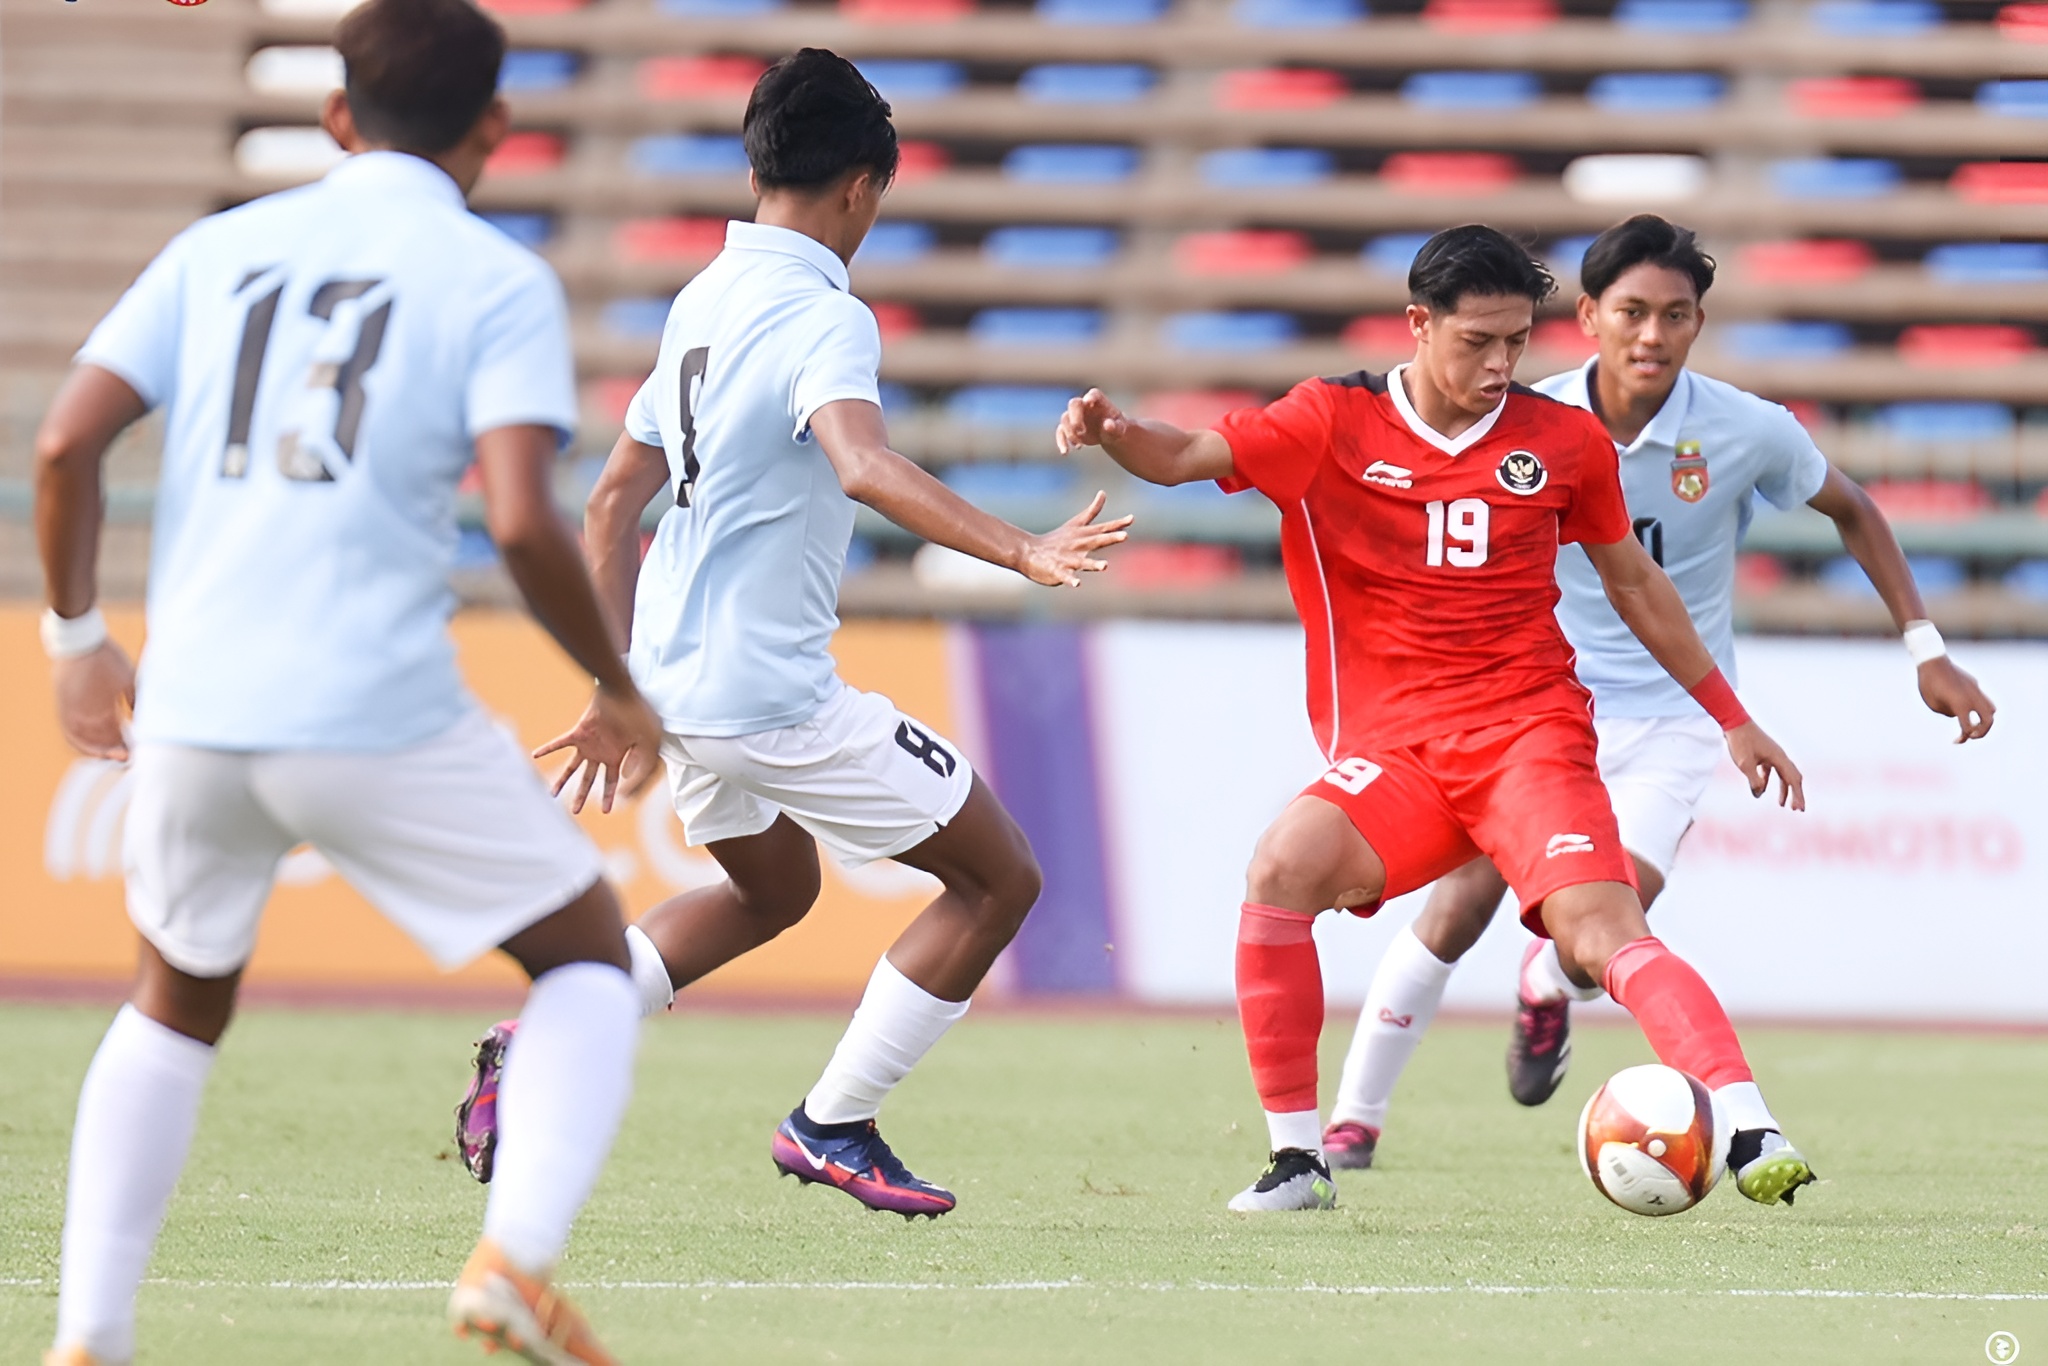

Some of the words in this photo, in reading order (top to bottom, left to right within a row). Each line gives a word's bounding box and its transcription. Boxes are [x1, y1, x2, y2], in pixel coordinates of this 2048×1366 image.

[220, 264, 395, 482] 13
[1425, 498, 1490, 568] 19
[894, 720, 956, 778] 8
